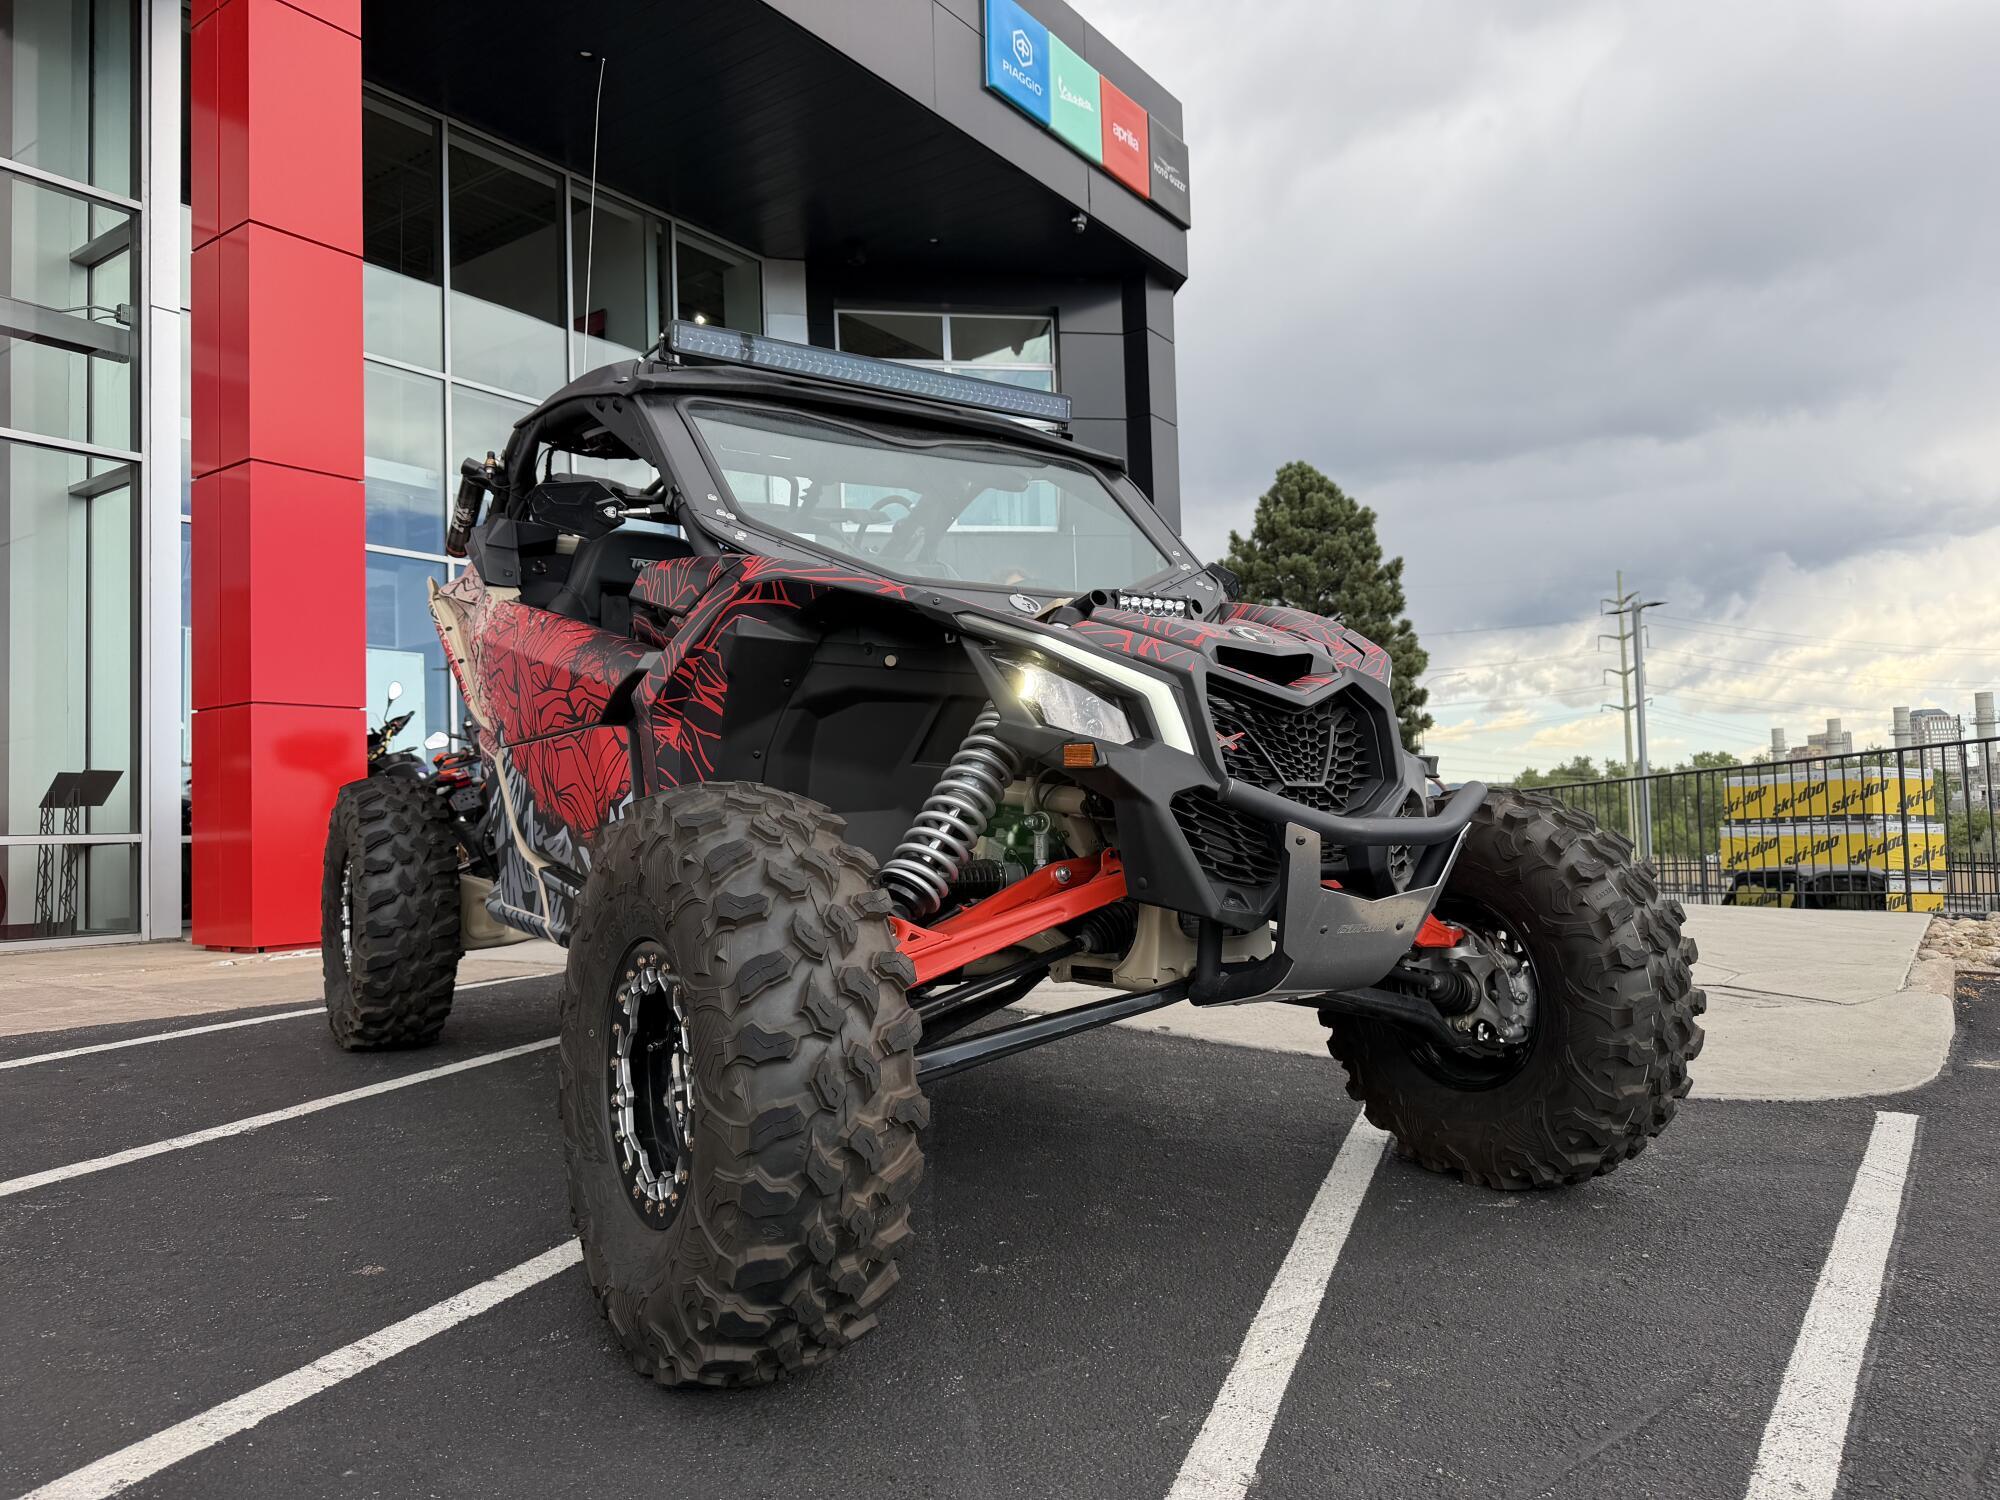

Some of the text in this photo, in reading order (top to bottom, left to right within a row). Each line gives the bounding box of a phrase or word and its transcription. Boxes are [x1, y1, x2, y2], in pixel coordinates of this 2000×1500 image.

[1002, 58, 1042, 97] PIAGGIO
[1112, 122, 1139, 153] aprilia
[1831, 779, 1890, 814] ski-doo
